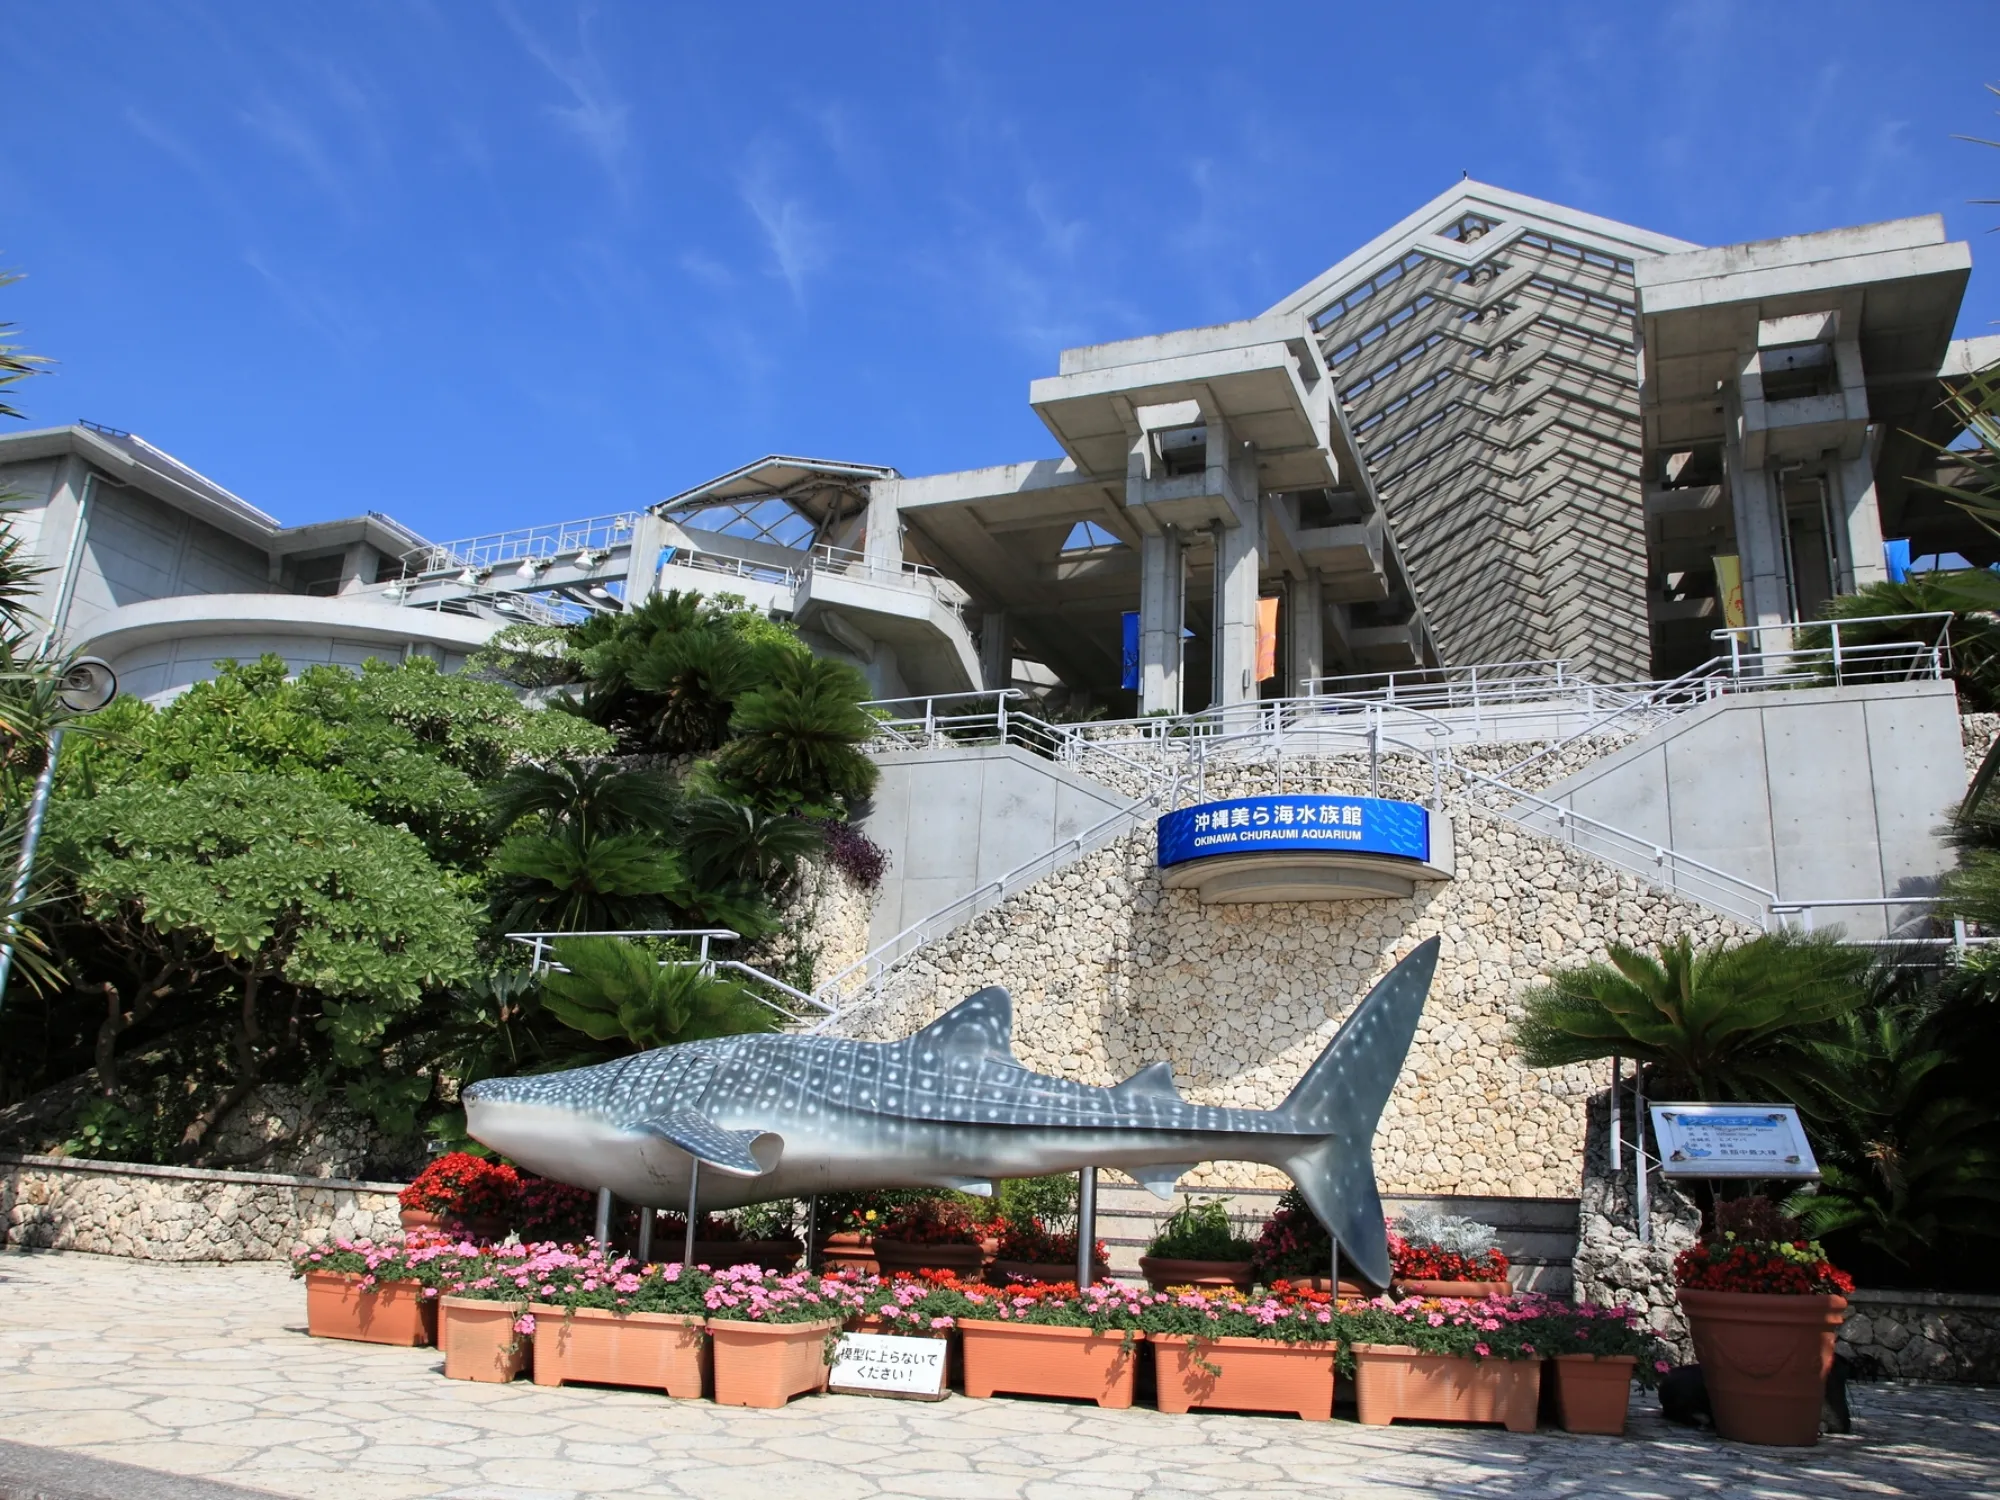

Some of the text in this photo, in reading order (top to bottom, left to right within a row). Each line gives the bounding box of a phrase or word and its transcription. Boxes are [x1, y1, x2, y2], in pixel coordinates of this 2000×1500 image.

[1194, 804, 1363, 833] 沖縄美ら海水族館
[1194, 828, 1362, 847] OKINAWA CHURAUMI AQUARIUM
[840, 1347, 938, 1366] 模型に上らないで
[857, 1365, 913, 1382] ください!
